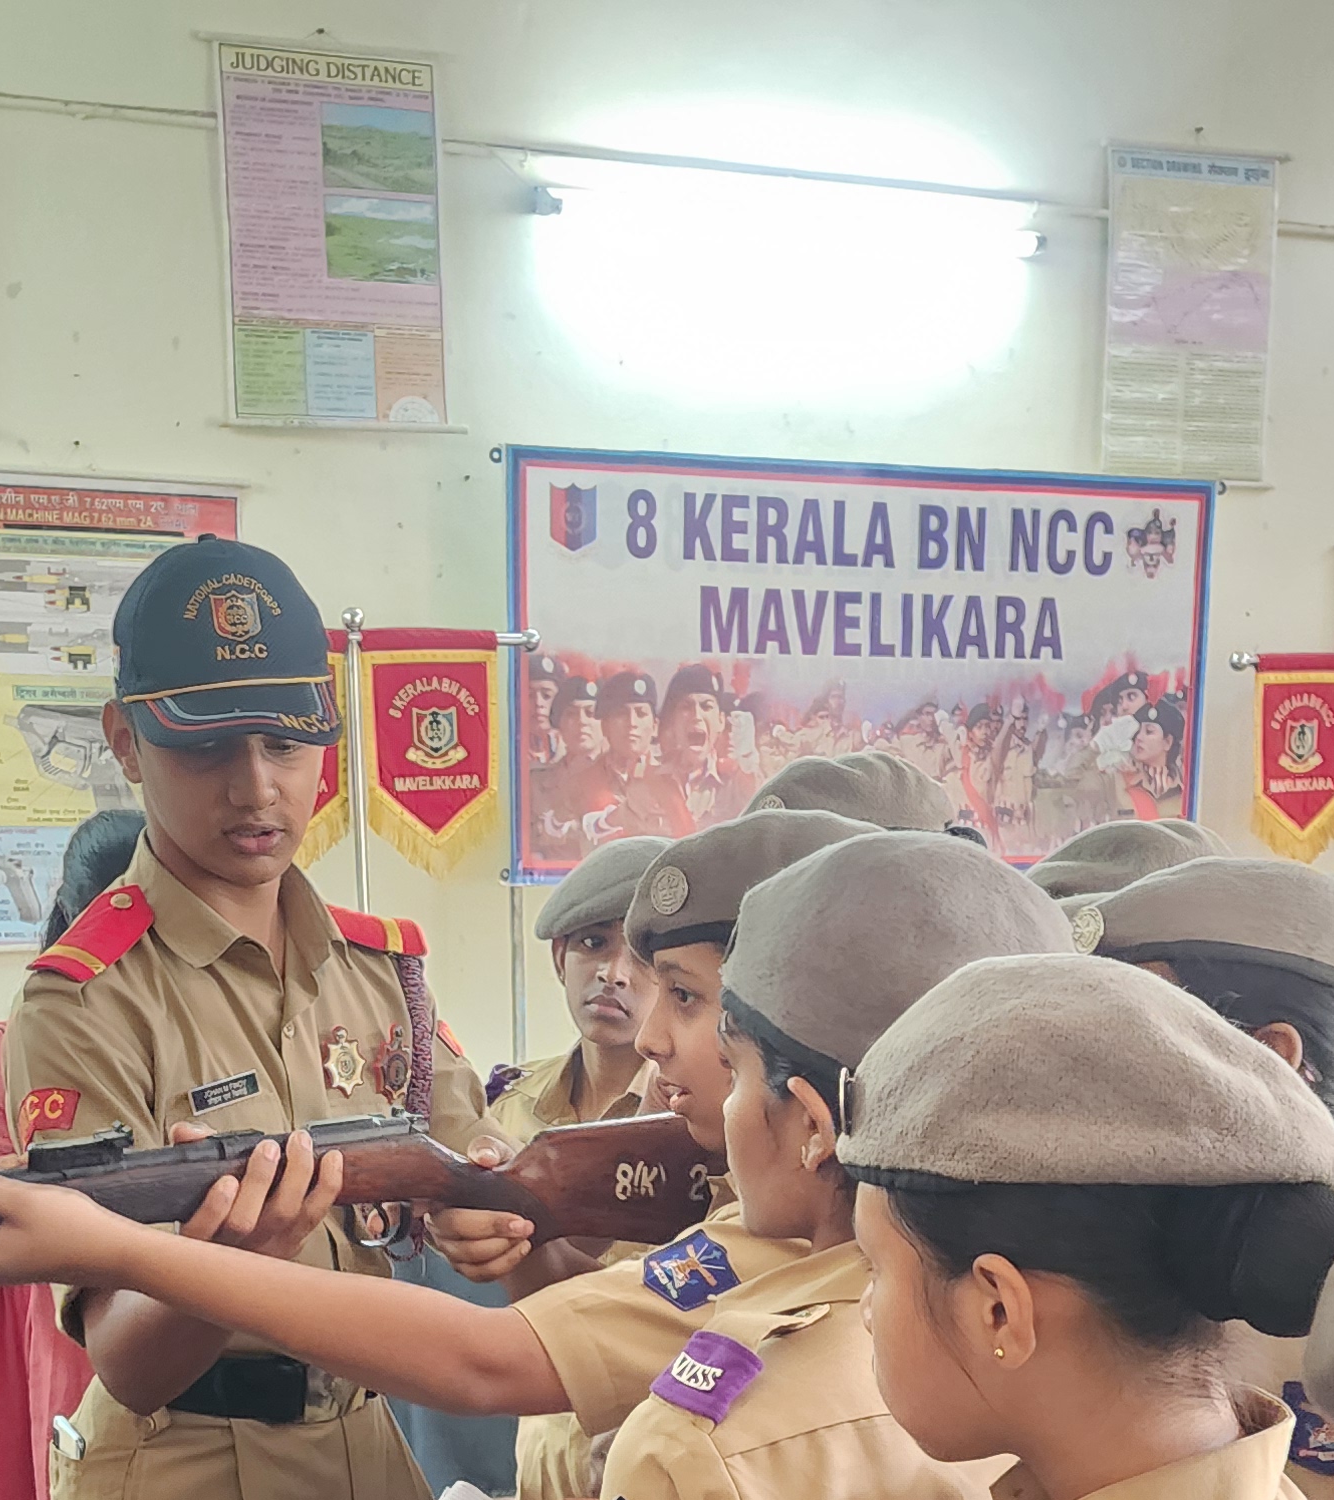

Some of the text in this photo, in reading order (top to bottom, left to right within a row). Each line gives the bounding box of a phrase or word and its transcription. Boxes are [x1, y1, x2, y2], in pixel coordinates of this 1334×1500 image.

[230, 51, 424, 87] JUDGING DISTANCE
[7, 508, 60, 523] MACHINE
[63, 512, 90, 525] MAG
[92, 514, 115, 526] 7.62
[625, 488, 1115, 576] 8 KERALA BN NCC
[183, 577, 223, 620] NATIONAL
[699, 584, 1064, 660] MAVELIKARA
[394, 675, 441, 712] KERALA
[457, 687, 481, 717] NCC
[278, 713, 331, 734] NCC
[394, 774, 481, 792] MAVELIKKARA
[670, 1350, 725, 1393] VVSS
